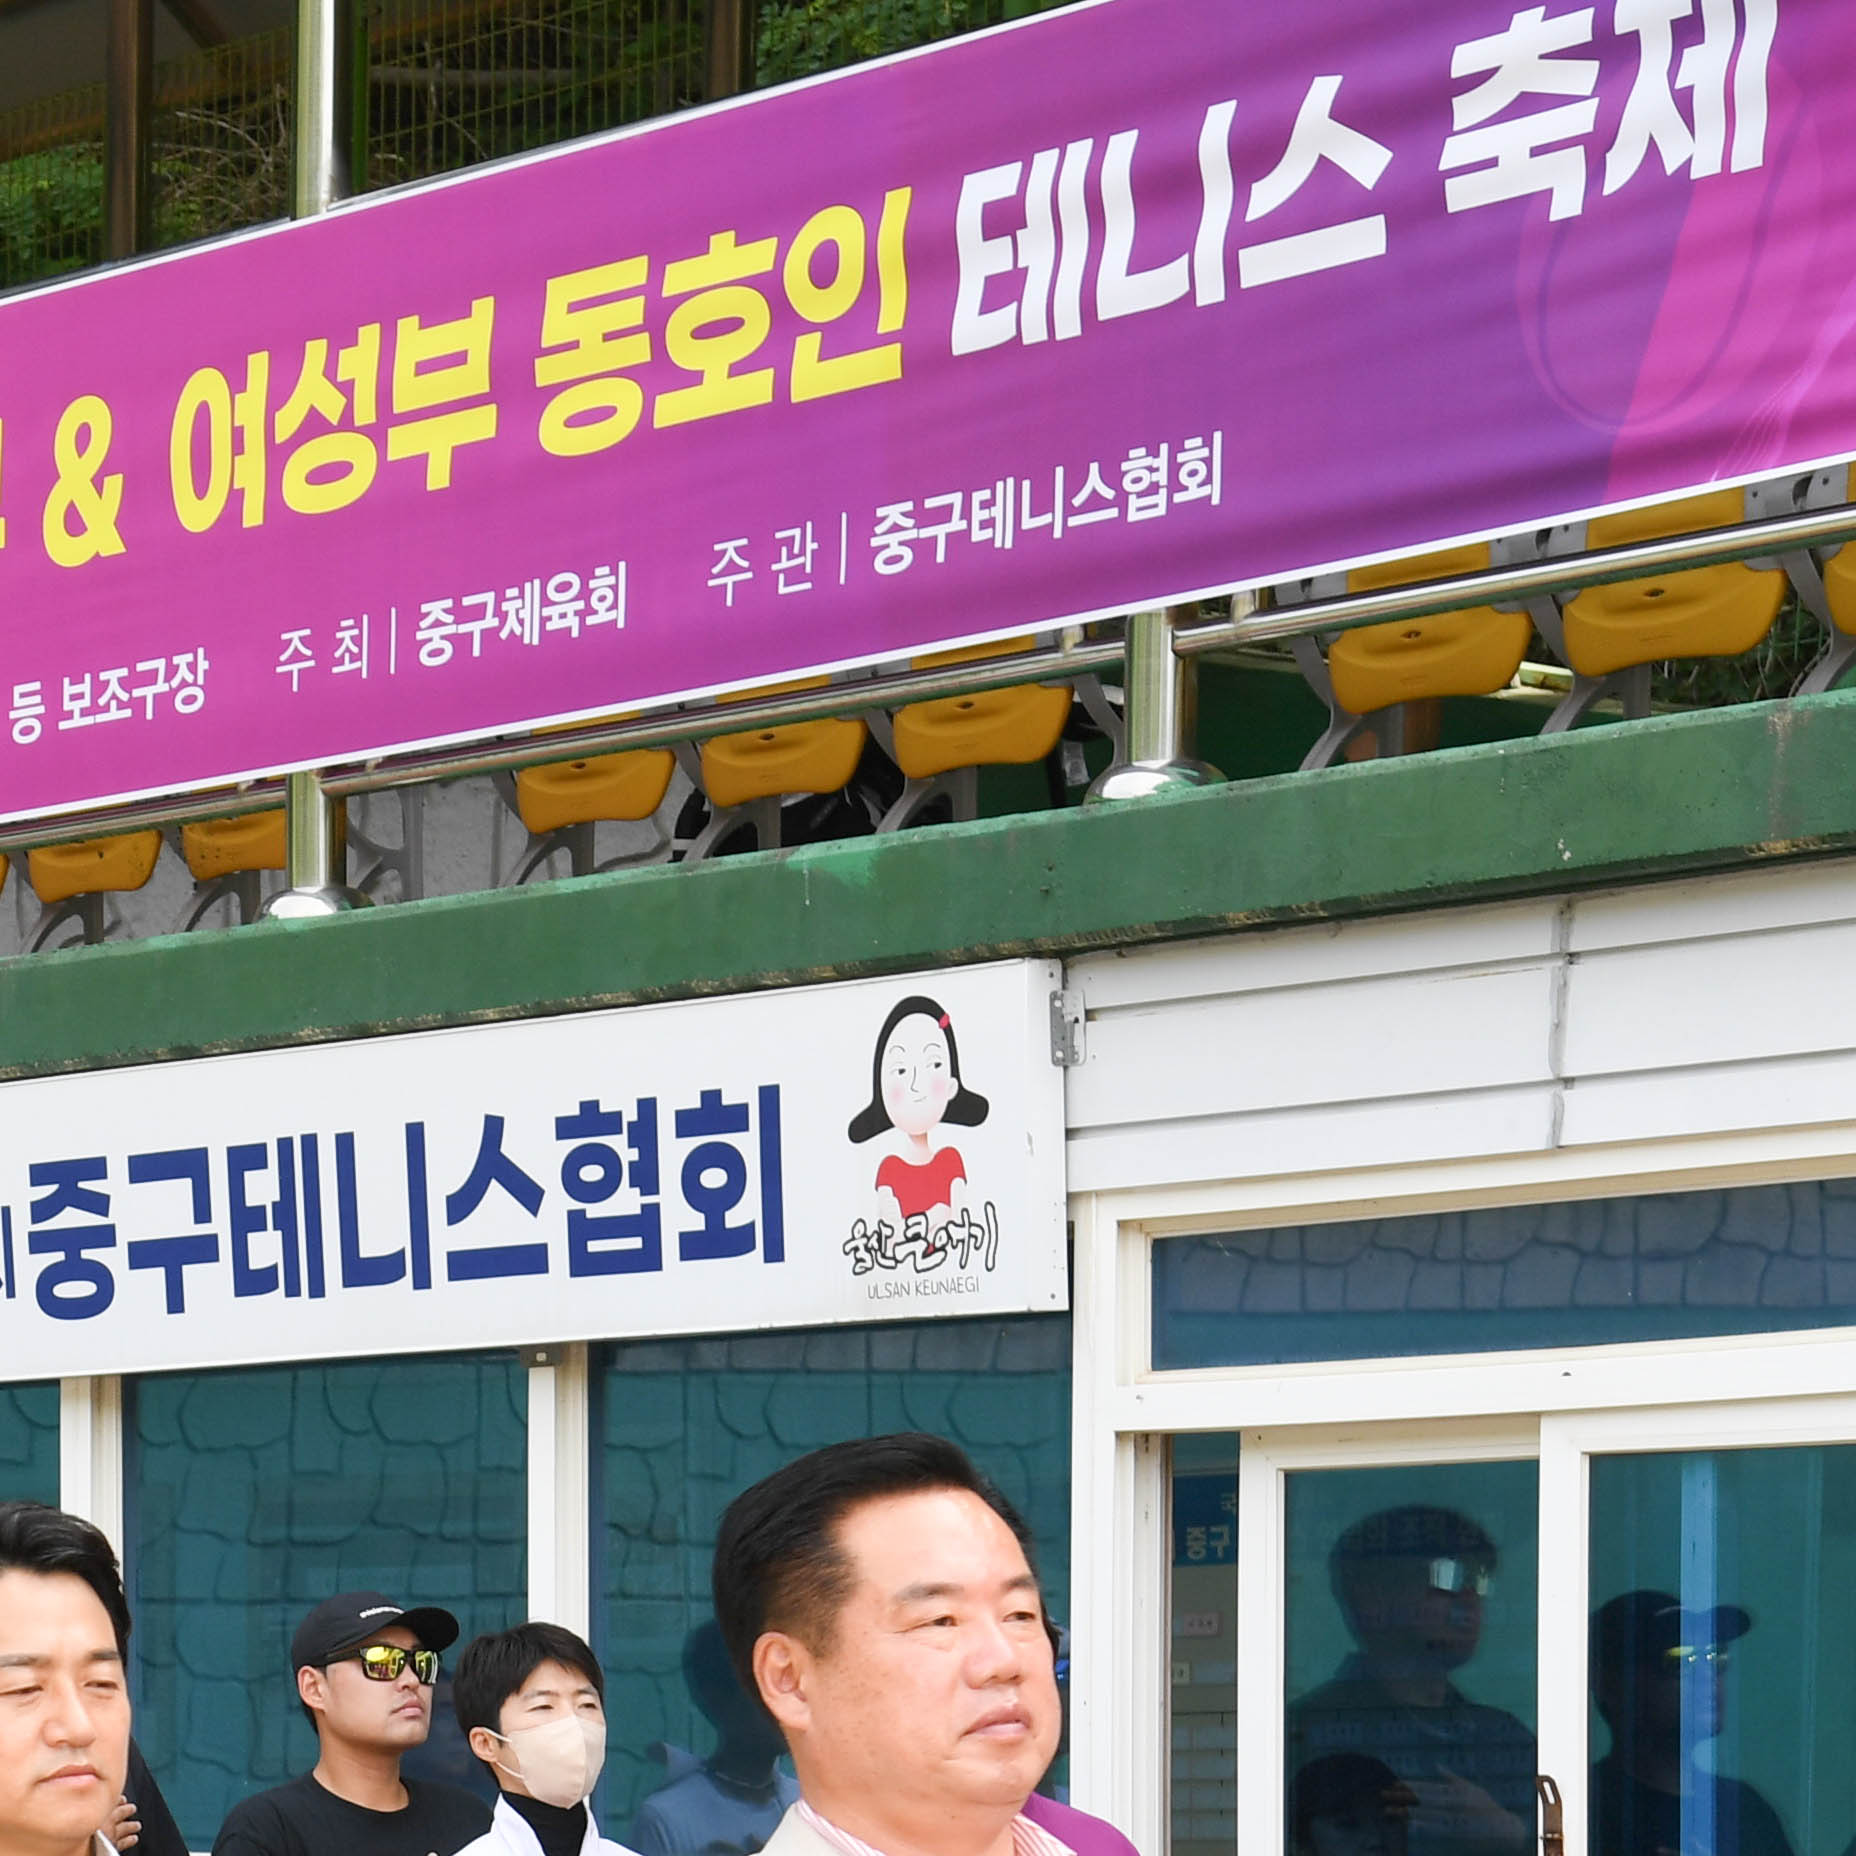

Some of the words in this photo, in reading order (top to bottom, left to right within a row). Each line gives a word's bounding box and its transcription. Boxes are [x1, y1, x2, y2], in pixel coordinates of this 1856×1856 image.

[42, 395, 127, 568] &
[170, 295, 498, 533] 여성부
[534, 186, 912, 457] 동호인
[951, 74, 1393, 356] 테니스
[1437, 0, 1779, 222] 축제
[9, 680, 46, 745] 등
[58, 646, 210, 732] 보조구장
[415, 560, 628, 667] 중구체육회
[870, 430, 1224, 576] 중구테니스협회
[27, 1084, 786, 1321] 중구테니스협회
[867, 1281, 911, 1300] ULSAN
[914, 1275, 980, 1297] KEUNAEGI
